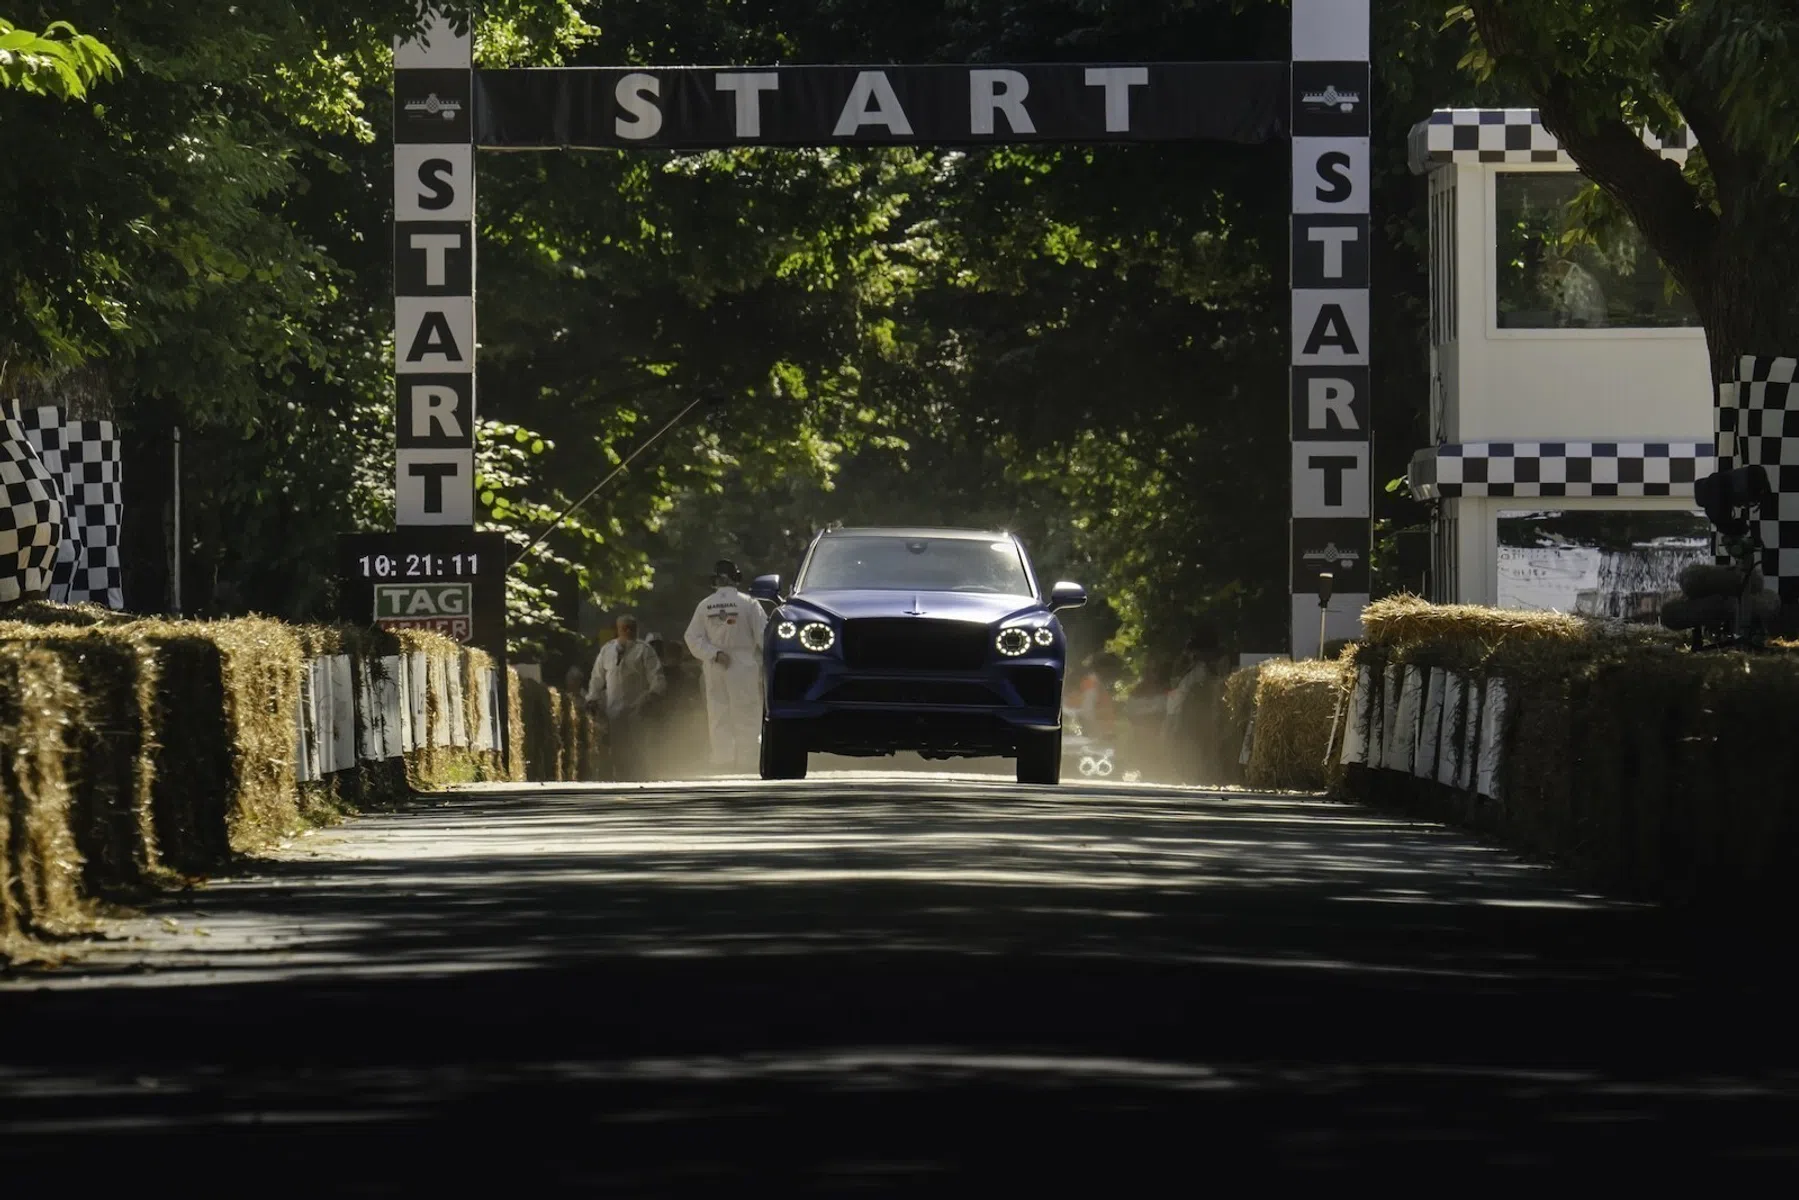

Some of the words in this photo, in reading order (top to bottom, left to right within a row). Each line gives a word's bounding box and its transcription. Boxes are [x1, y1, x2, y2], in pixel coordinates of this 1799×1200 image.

[616, 70, 1147, 139] START
[406, 159, 463, 513] START
[1302, 152, 1360, 506] START
[383, 589, 463, 614] TAG
